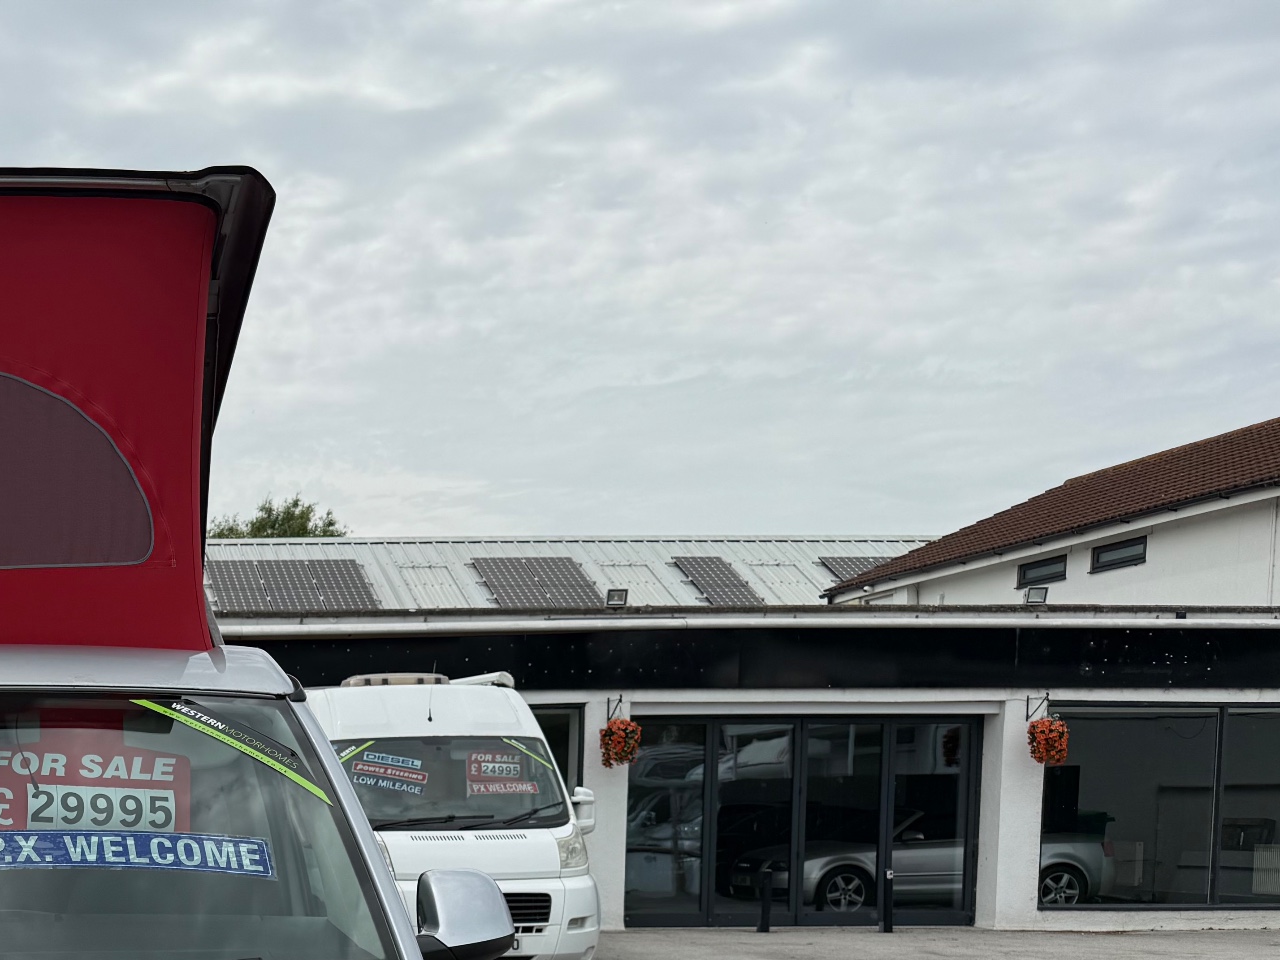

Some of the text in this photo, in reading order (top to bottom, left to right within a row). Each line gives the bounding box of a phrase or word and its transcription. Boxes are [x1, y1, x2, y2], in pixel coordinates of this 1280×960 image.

[171, 702, 300, 769] WESTERNMOTORHOMES
[365, 753, 420, 768] DIESEL
[471, 753, 520, 763] FOR SALE
[79, 754, 176, 782] SALE
[356, 764, 385, 774] POWER
[482, 764, 520, 777] 24995
[353, 776, 421, 795] LOW MILEAGE
[489, 783, 534, 793] WELCOME
[30, 789, 173, 829] 29995
[63, 835, 265, 872] WELCOME
